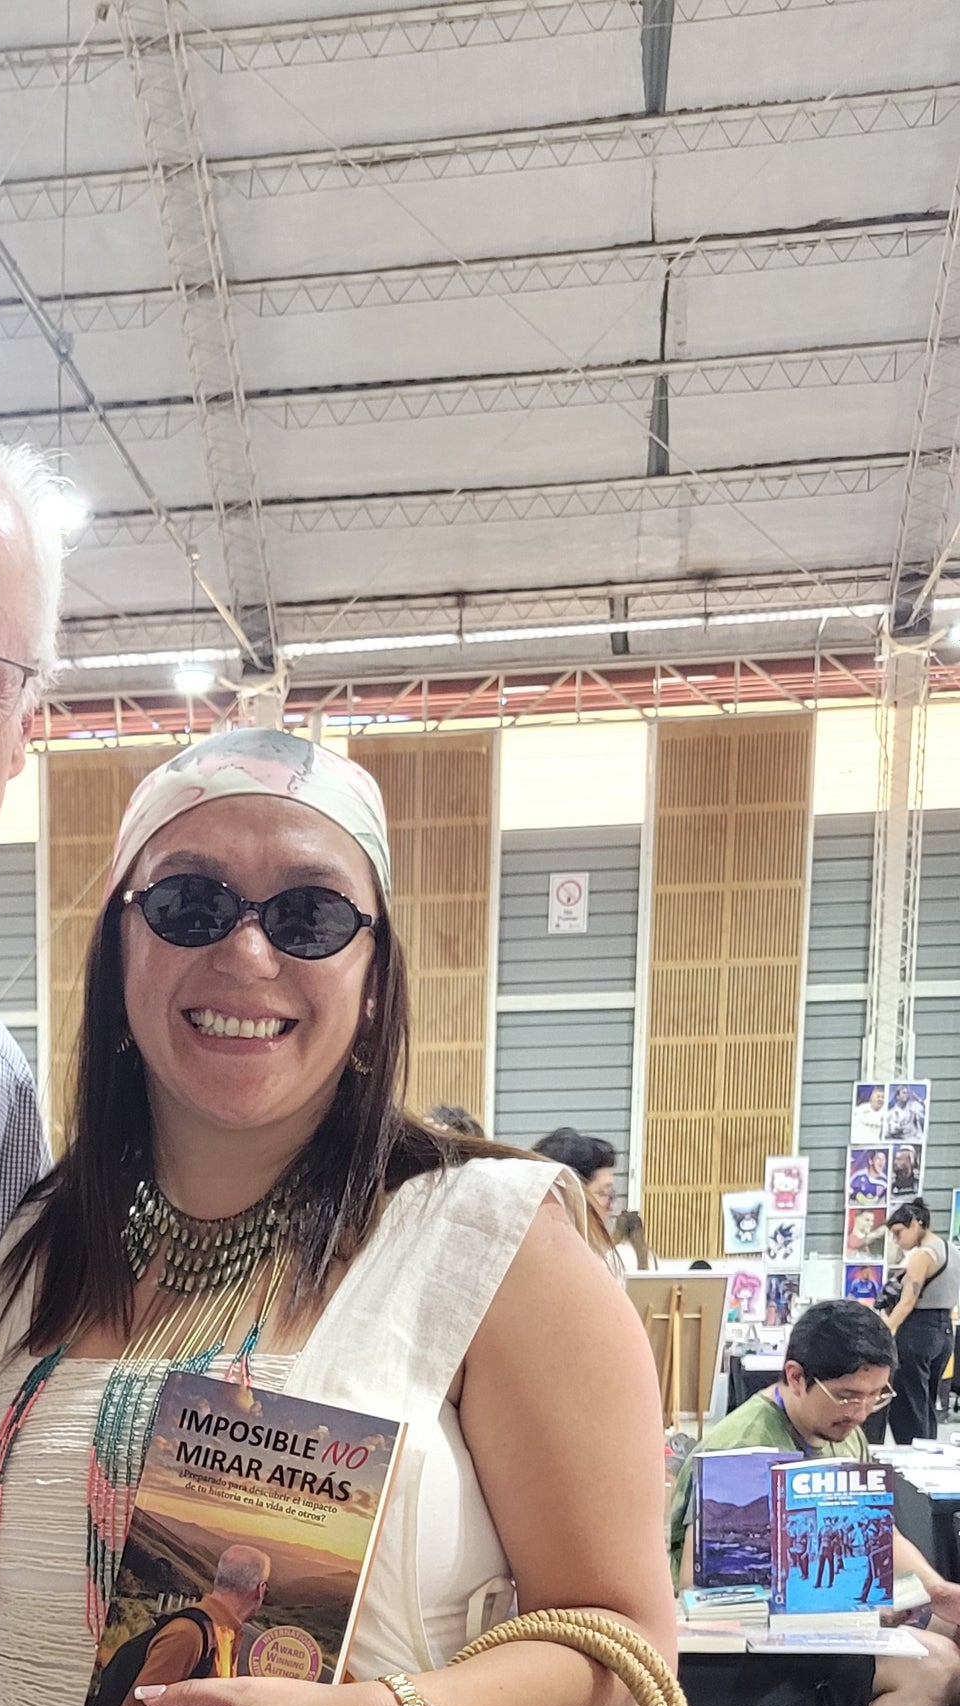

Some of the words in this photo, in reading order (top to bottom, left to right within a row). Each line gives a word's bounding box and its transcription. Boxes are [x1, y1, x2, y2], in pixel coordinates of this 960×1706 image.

[178, 1407, 319, 1460] IMPOSIBLE
[321, 1440, 369, 1470] NO
[175, 1441, 263, 1481] MIRAR
[267, 1464, 352, 1502] ATRÁS
[178, 1469, 227, 1487] ¿Preparado
[227, 1481, 248, 1492] para
[249, 1485, 291, 1503] descubrir
[292, 1494, 302, 1504] el
[302, 1499, 338, 1514] impacto
[792, 1469, 887, 1494] CHILE
[184, 1481, 196, 1492] de
[197, 1485, 208, 1494] tu
[208, 1487, 241, 1502] historia
[243, 1496, 255, 1505] en
[255, 1497, 264, 1507] la
[265, 1501, 284, 1512] vida
[285, 1505, 297, 1515] de
[297, 1510, 327, 1523] otros?
